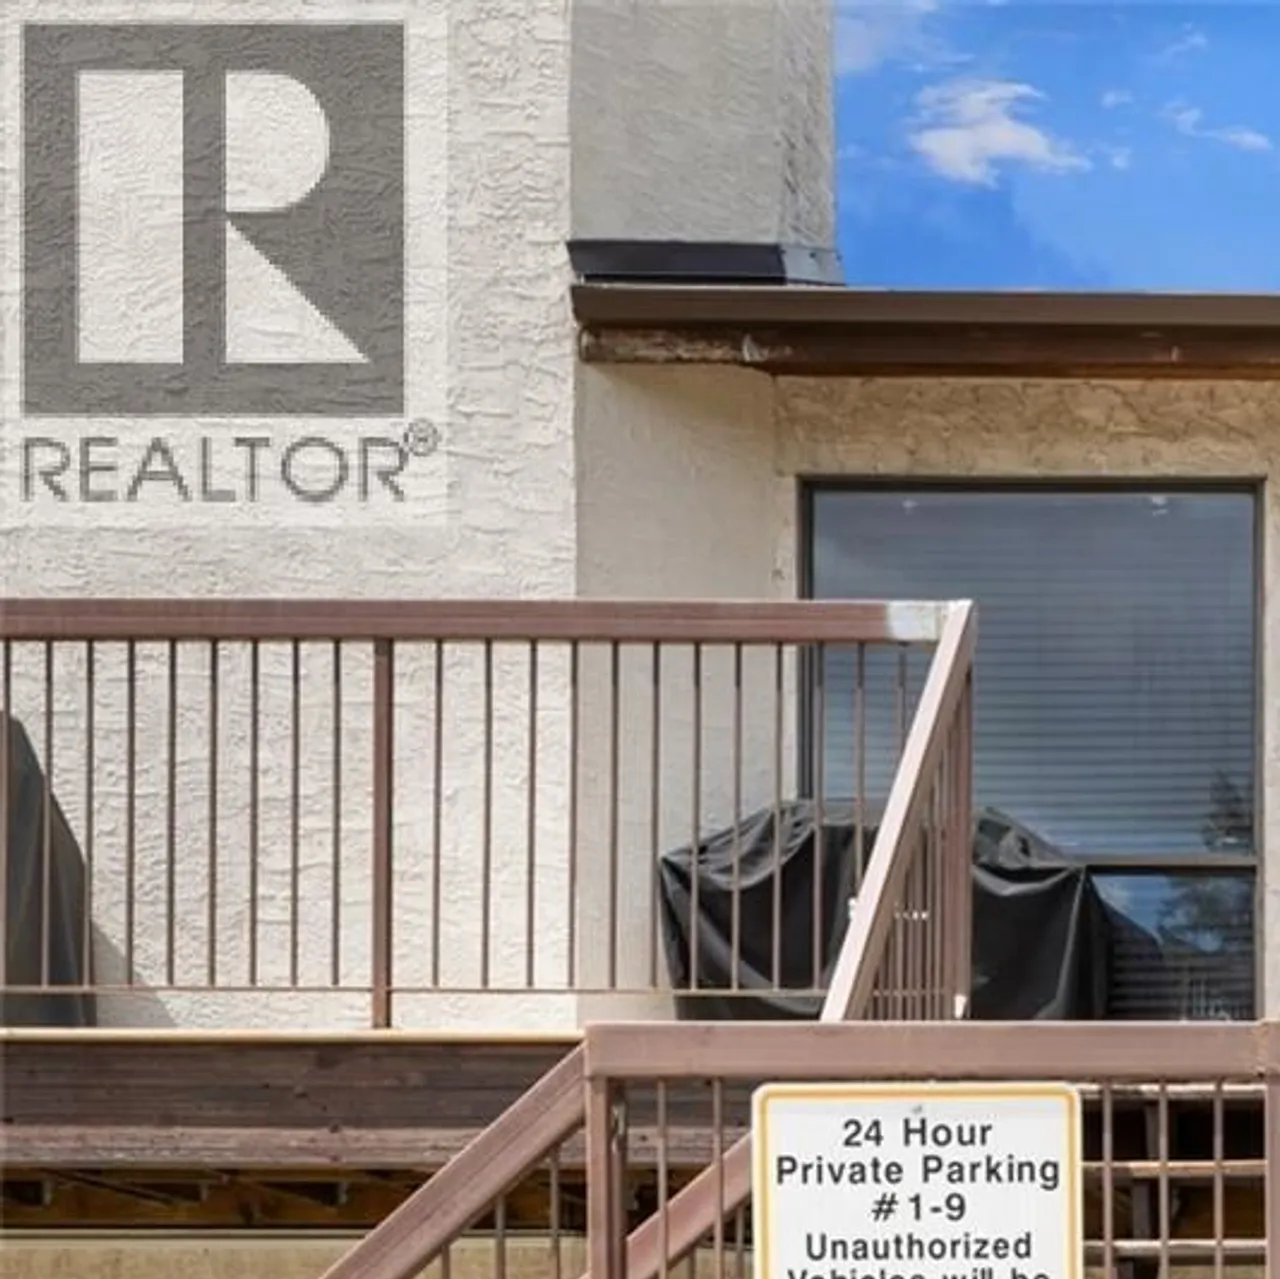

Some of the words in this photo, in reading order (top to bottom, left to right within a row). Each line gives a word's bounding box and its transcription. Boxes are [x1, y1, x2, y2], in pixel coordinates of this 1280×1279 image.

[843, 1119, 884, 1147] 24
[903, 1118, 993, 1147] Hour
[776, 1156, 904, 1185] Private
[922, 1154, 1060, 1191] Parking
[805, 1232, 1032, 1260] Unauthorized
